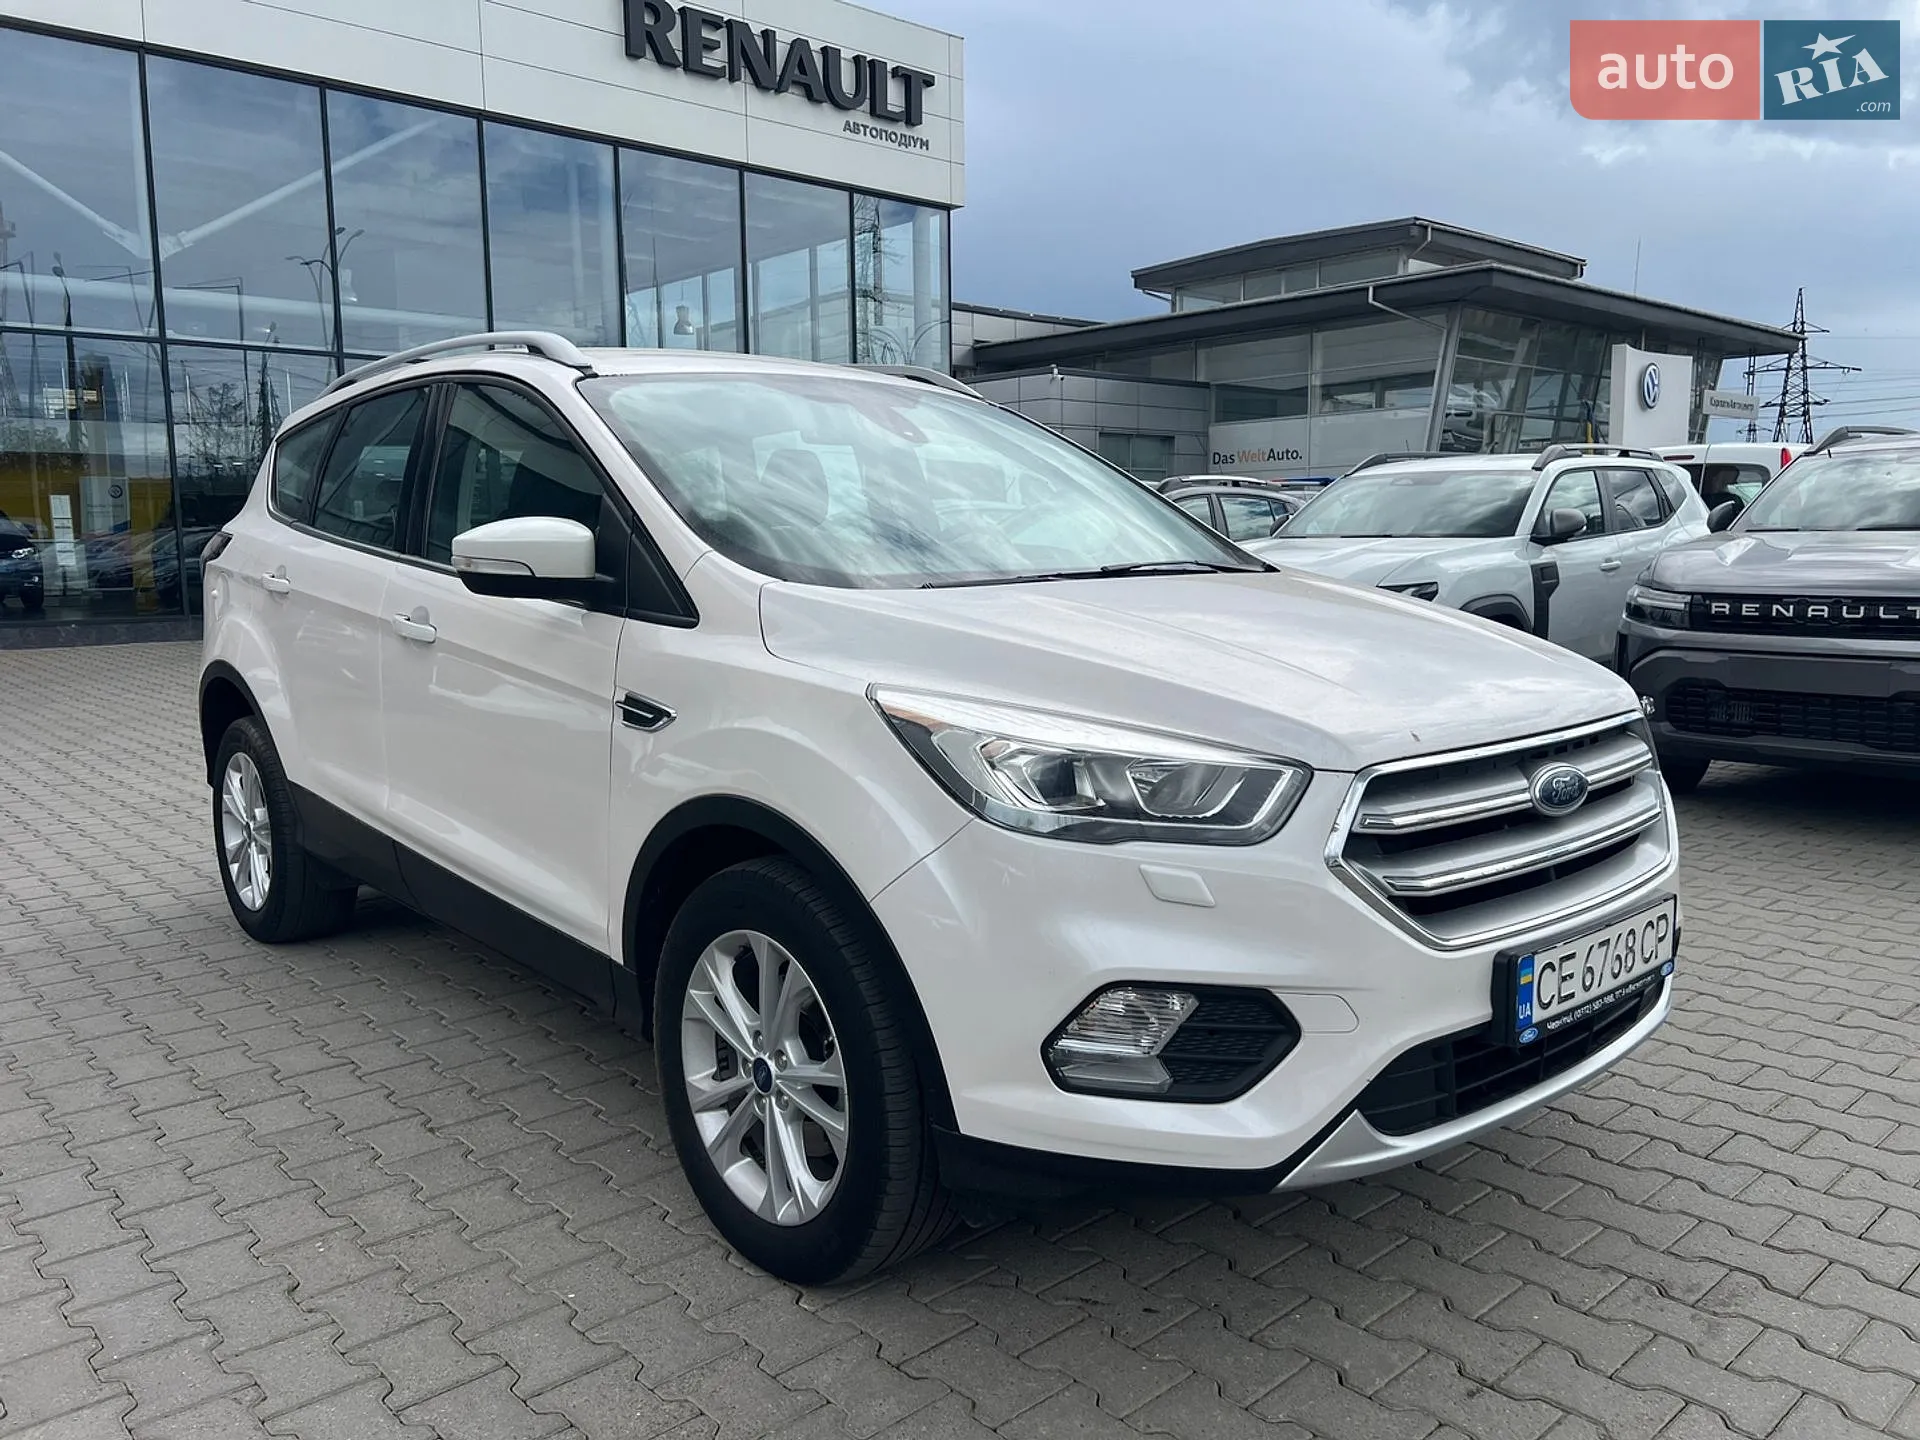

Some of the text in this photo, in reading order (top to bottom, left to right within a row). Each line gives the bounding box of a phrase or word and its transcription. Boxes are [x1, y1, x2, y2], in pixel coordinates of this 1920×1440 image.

[623, 0, 936, 127] RENAULT
[842, 119, 930, 151] АВТОПОДІУМ
[1212, 451, 1236, 465] Das
[1711, 602, 1920, 620] RENAULT
[1537, 912, 1670, 1010] CE 6768 CP
[1518, 1001, 1532, 1020] UA
